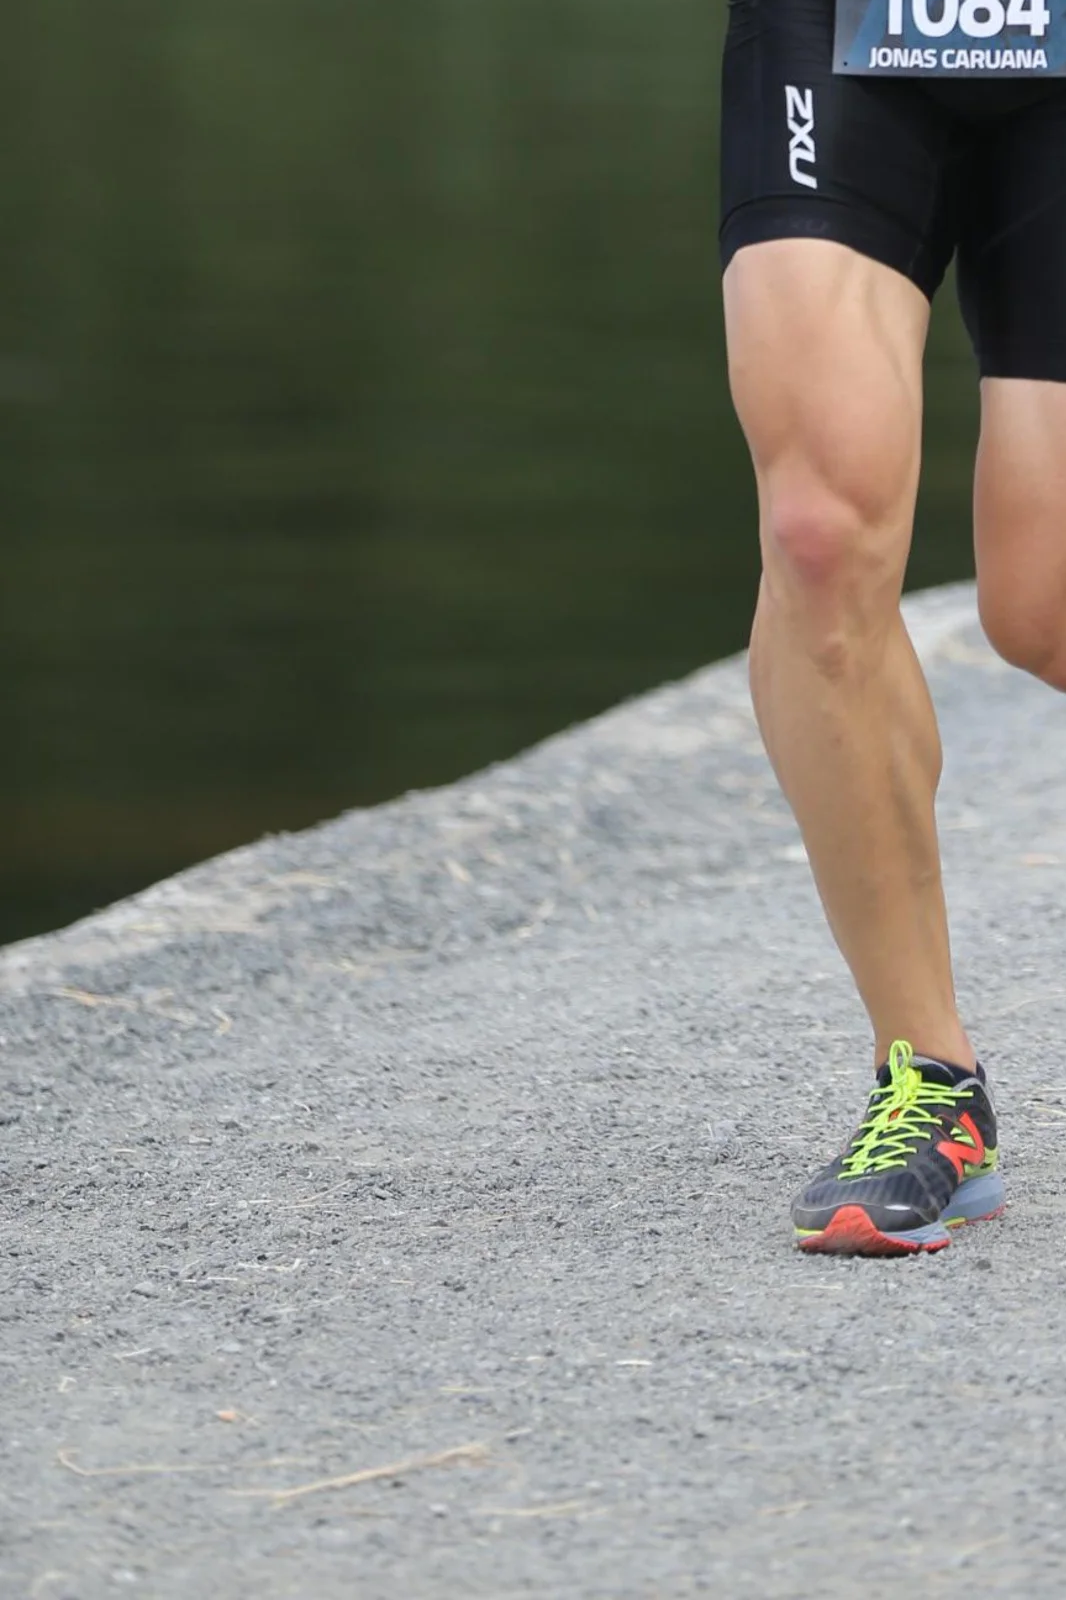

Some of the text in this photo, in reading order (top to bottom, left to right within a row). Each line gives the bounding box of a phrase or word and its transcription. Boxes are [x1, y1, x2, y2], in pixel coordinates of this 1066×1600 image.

[869, 47, 1048, 69] JONAS CARUANA
[784, 84, 818, 190] 2XU
